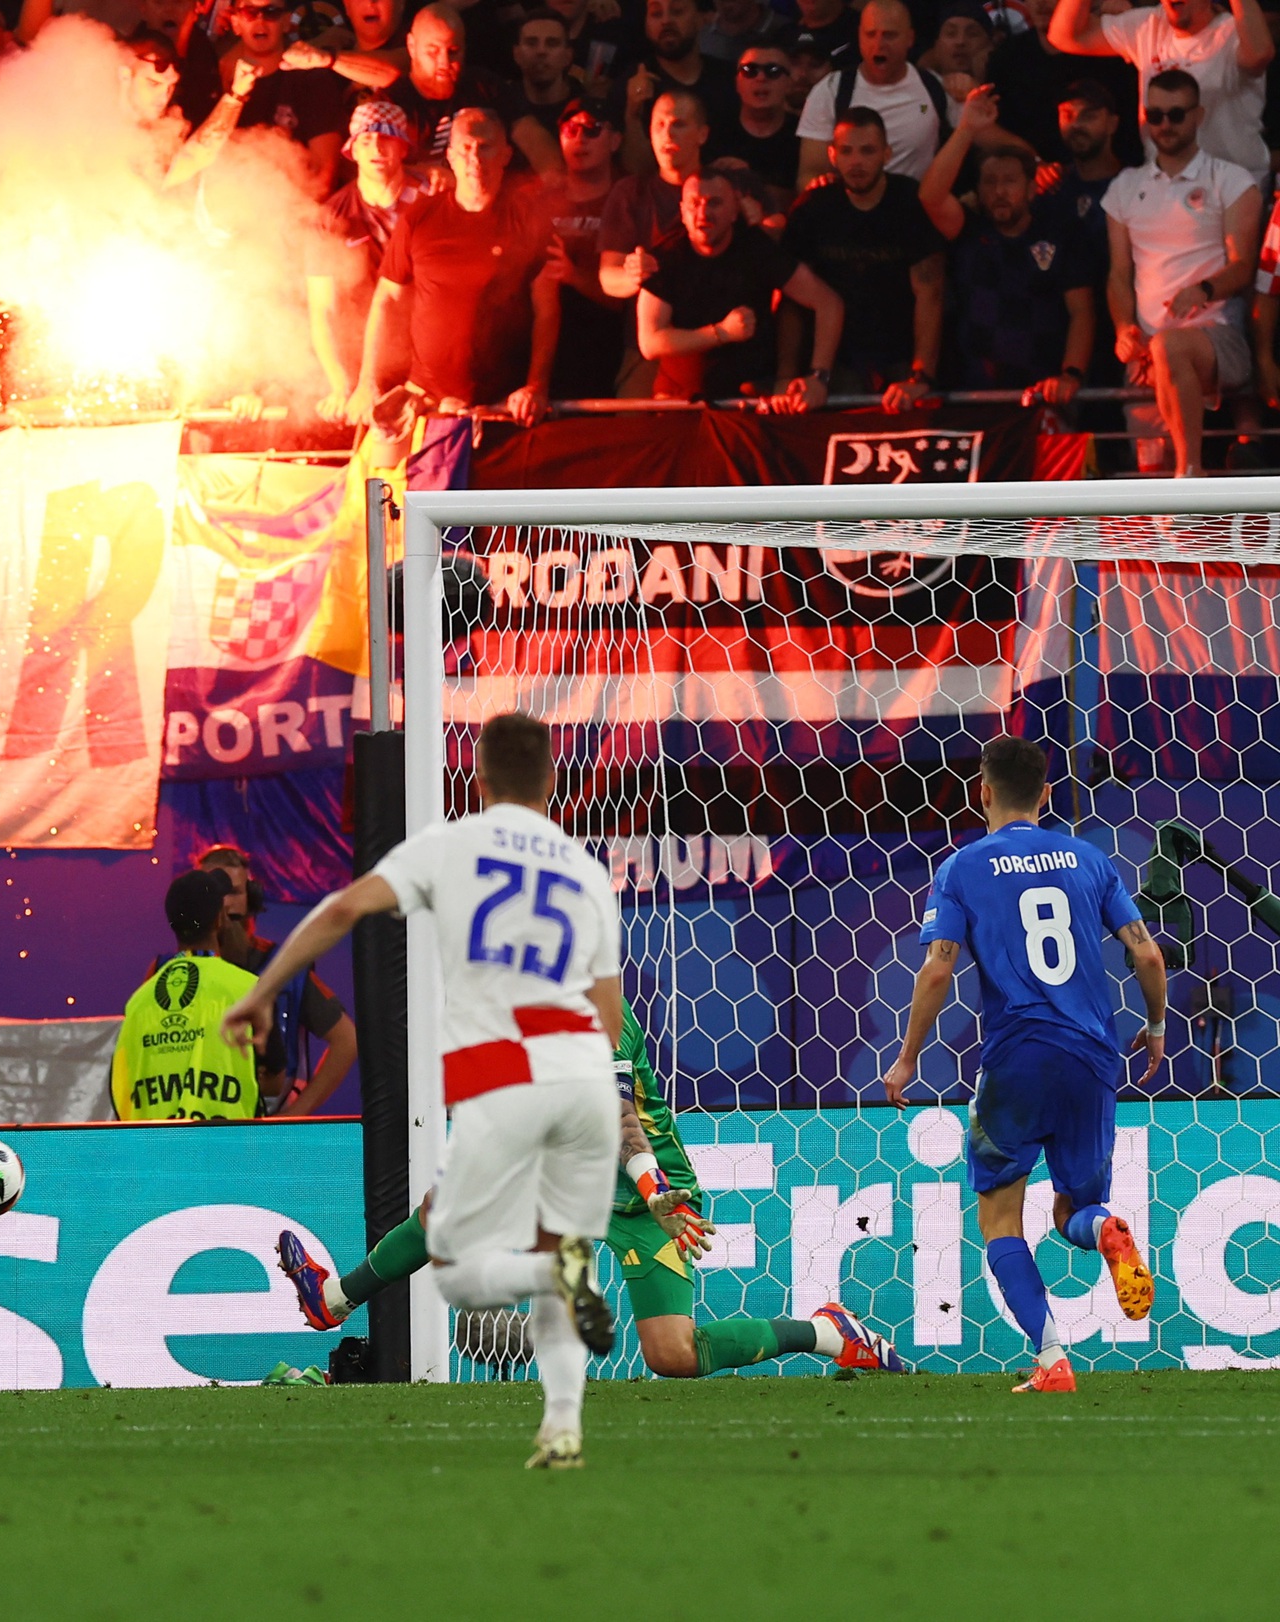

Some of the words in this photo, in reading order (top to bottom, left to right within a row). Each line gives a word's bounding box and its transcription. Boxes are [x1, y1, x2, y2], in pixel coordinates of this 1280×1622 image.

[988, 850, 1079, 877] JORGINHO
[467, 856, 584, 986] 25
[1018, 886, 1077, 987] 8
[130, 1067, 242, 1110] TEWARD
